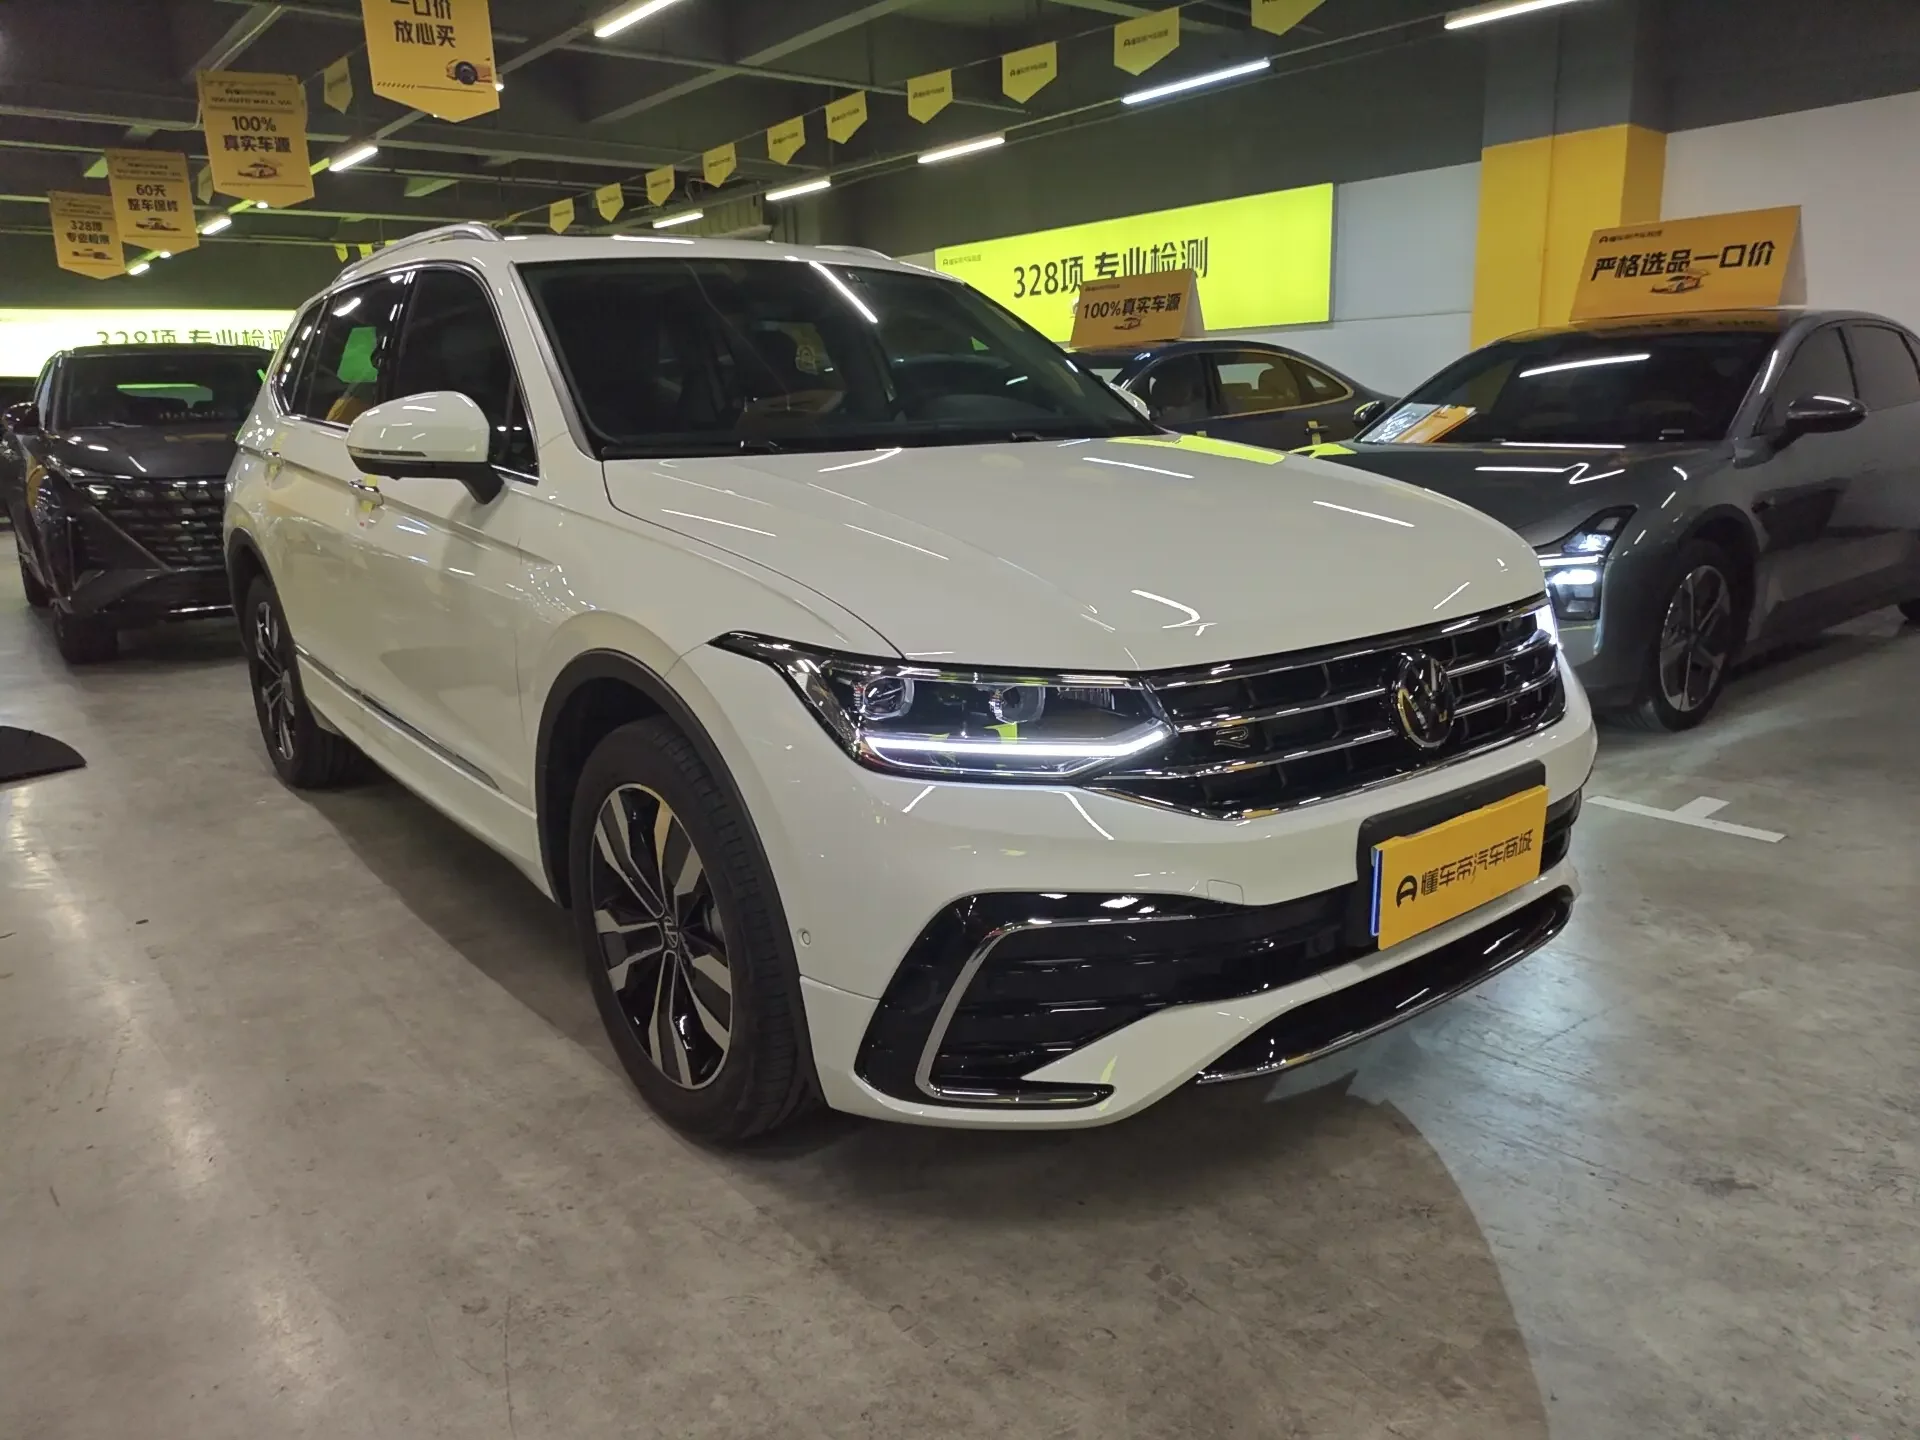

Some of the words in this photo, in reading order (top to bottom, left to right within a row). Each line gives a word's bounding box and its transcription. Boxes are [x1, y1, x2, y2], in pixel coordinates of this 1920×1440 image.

[393, 20, 456, 48] 放心买
[232, 116, 277, 132] 100%
[223, 135, 292, 153] 真实车源
[136, 184, 167, 197] 60天
[1013, 255, 1084, 299] 328项
[1094, 236, 1208, 279] 专业检测
[1590, 240, 1776, 281] 严格选品一口价
[1083, 292, 1182, 319] 100%真实车源
[1420, 828, 1534, 896] 懂车帝汽车商城
